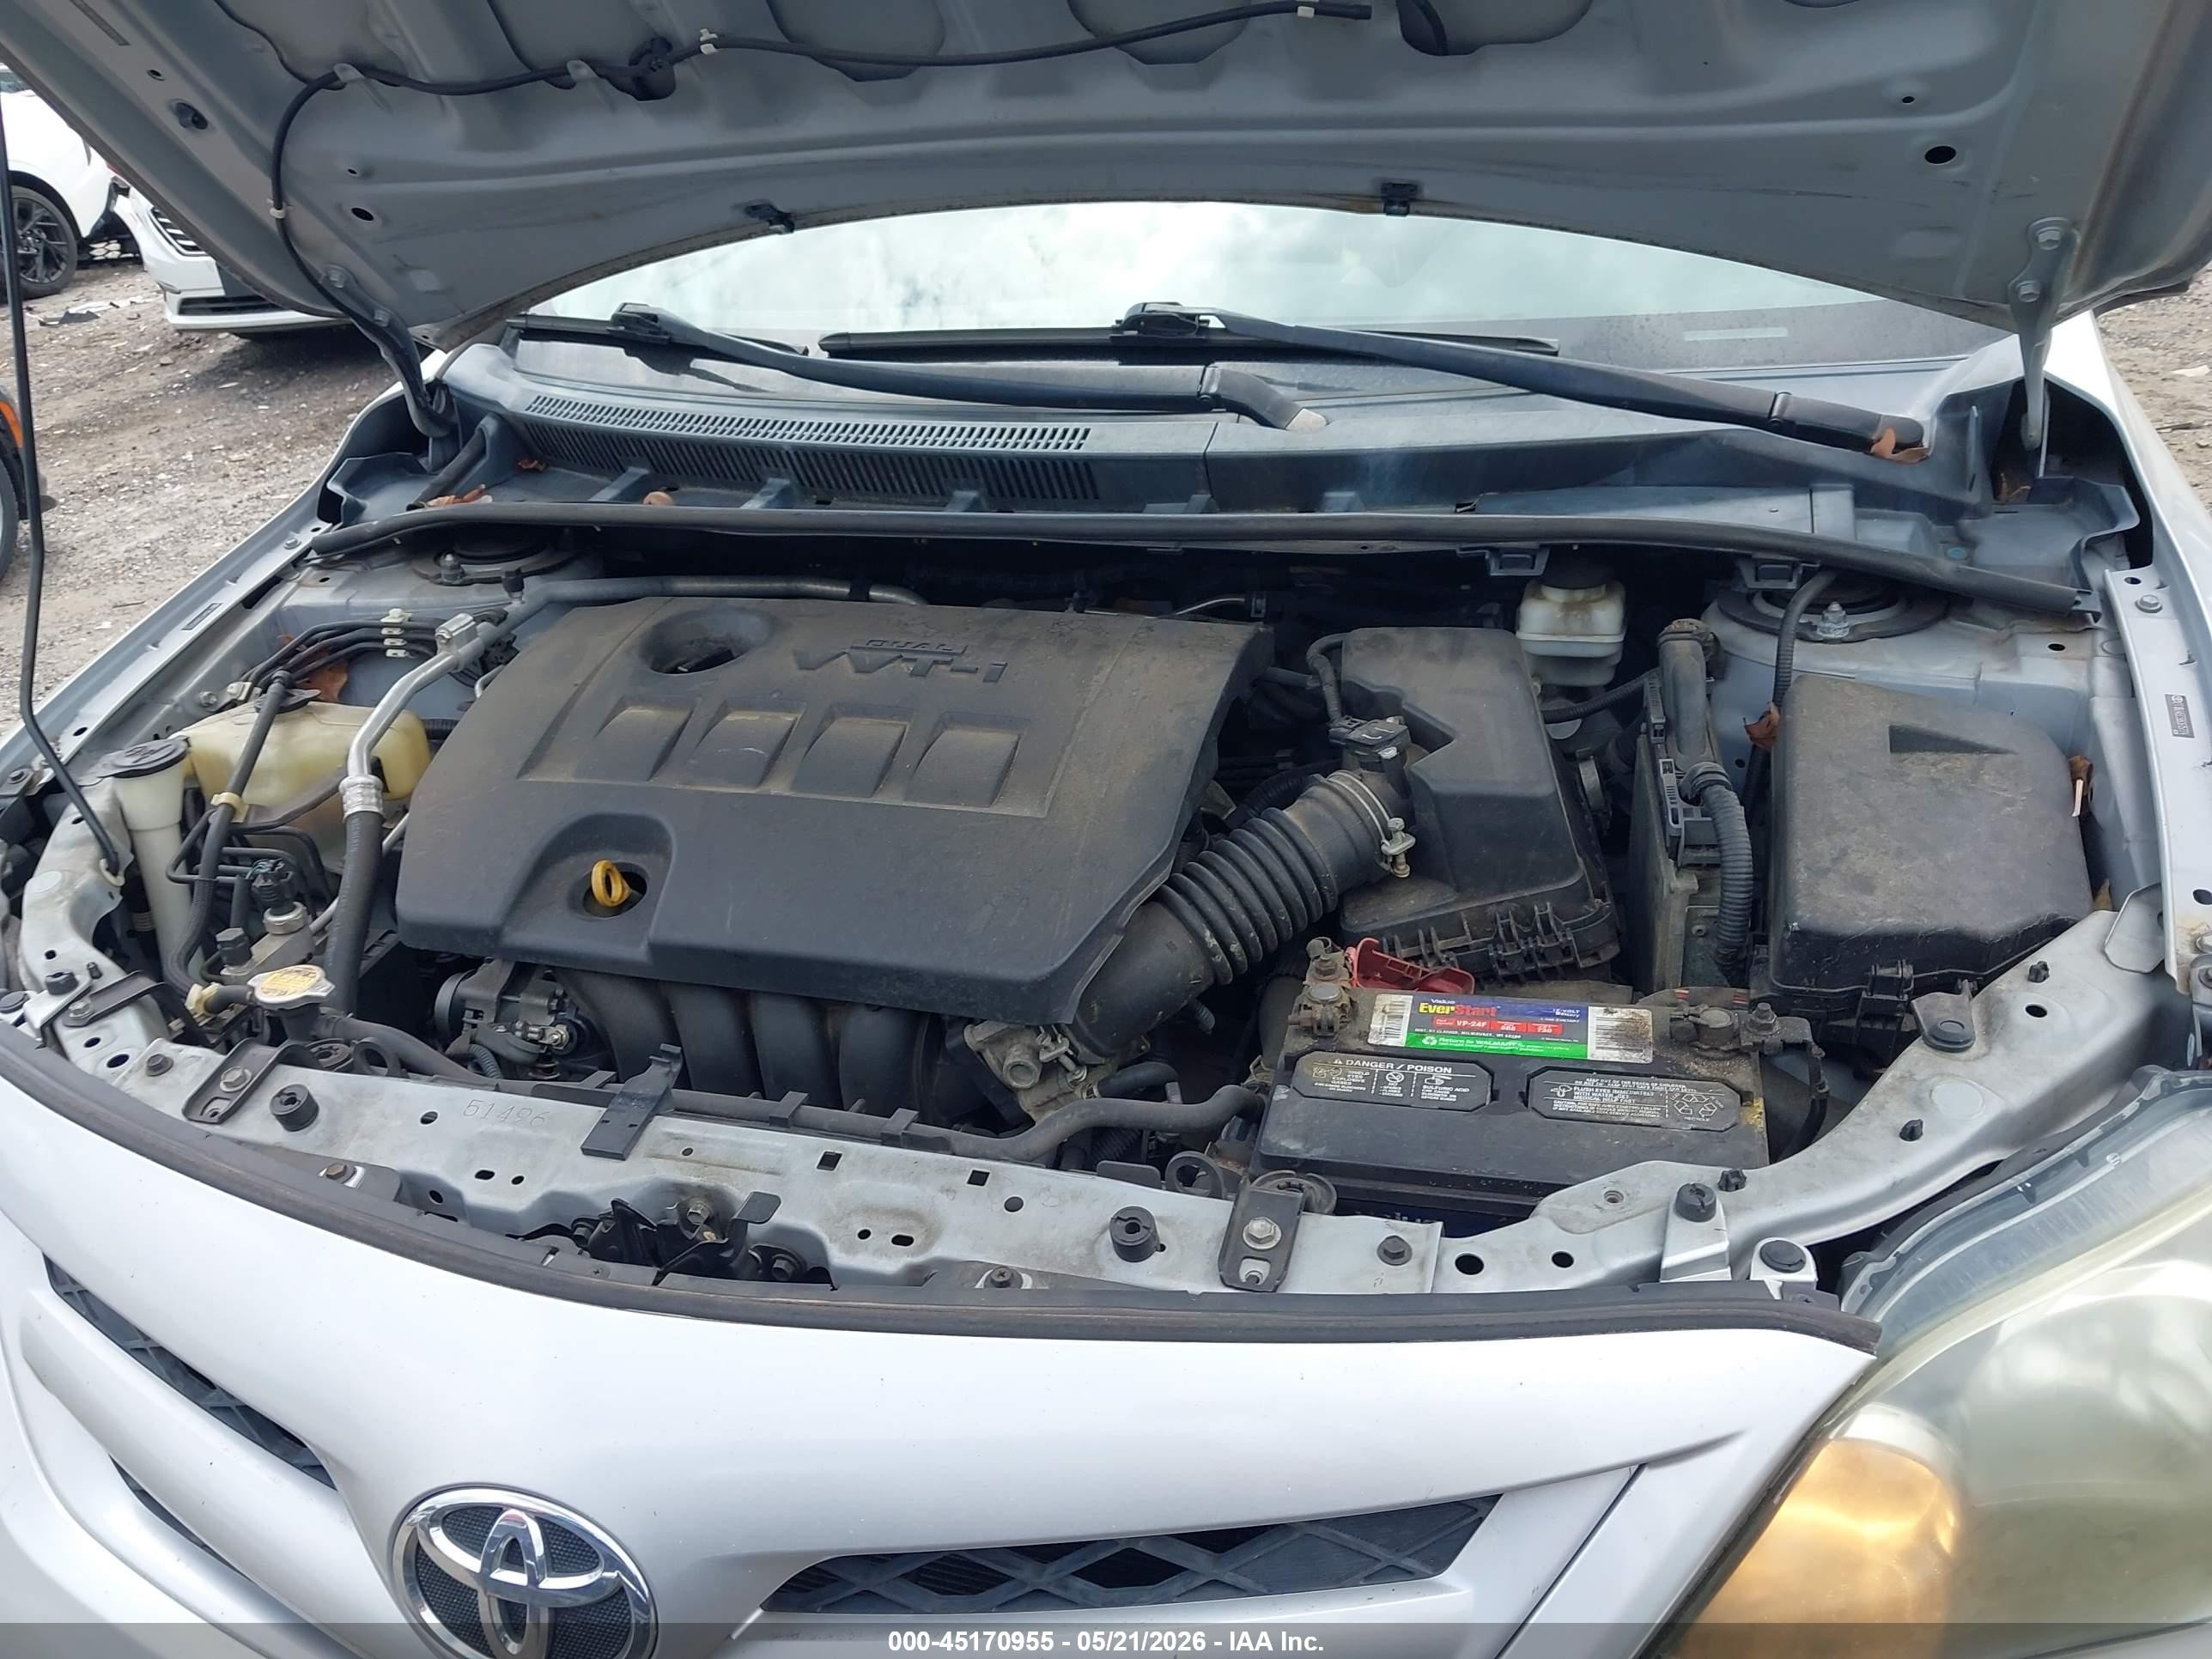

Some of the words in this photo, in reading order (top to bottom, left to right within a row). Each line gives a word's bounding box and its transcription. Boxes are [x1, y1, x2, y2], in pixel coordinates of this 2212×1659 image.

[1419, 1002, 1498, 1018] EverStart
[1456, 1019, 1487, 1028] VP-24F
[1346, 1060, 1394, 1069] DANGER
[1407, 1065, 1452, 1073] POISON
